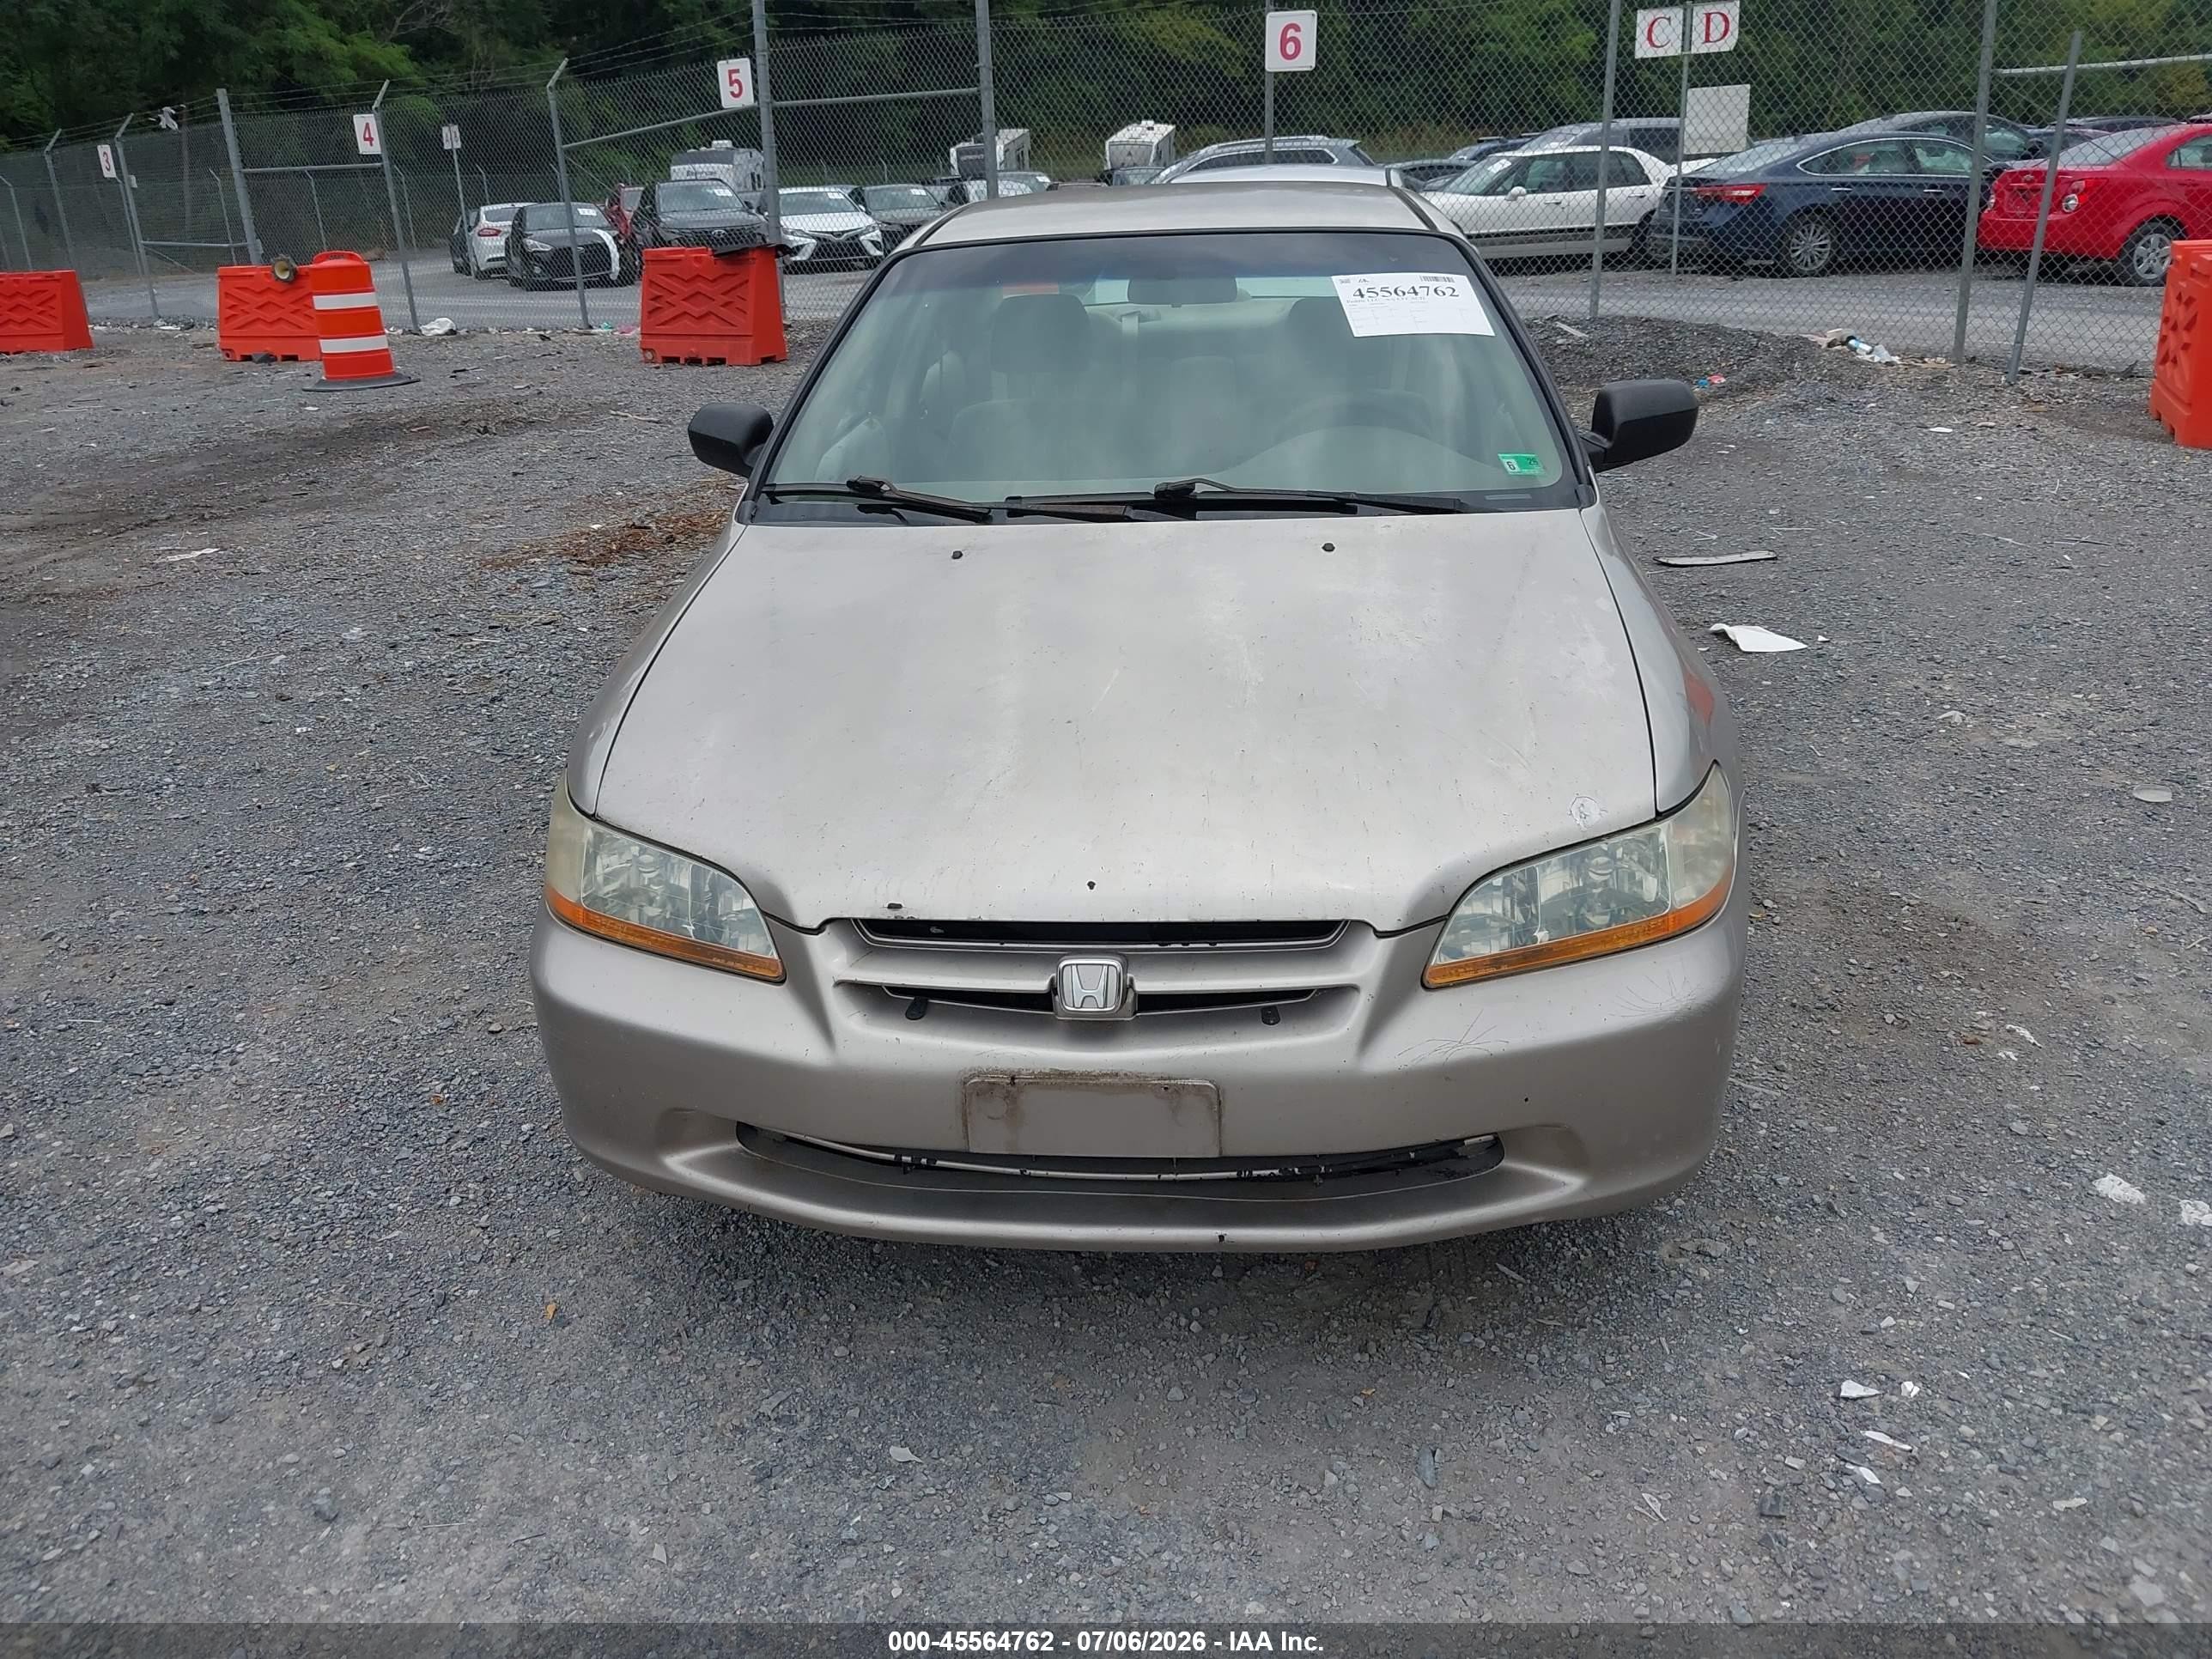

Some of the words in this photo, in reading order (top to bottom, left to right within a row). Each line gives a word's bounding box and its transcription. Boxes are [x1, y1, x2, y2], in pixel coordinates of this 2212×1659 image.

[1279, 22, 1302, 60] 6
[1647, 15, 1672, 49] C
[1702, 11, 1730, 45] D
[727, 68, 744, 99] 5
[362, 122, 374, 147] 4
[103, 150, 112, 173] 3
[1352, 285, 1460, 299] 45564762
[1505, 460, 1516, 471] 6
